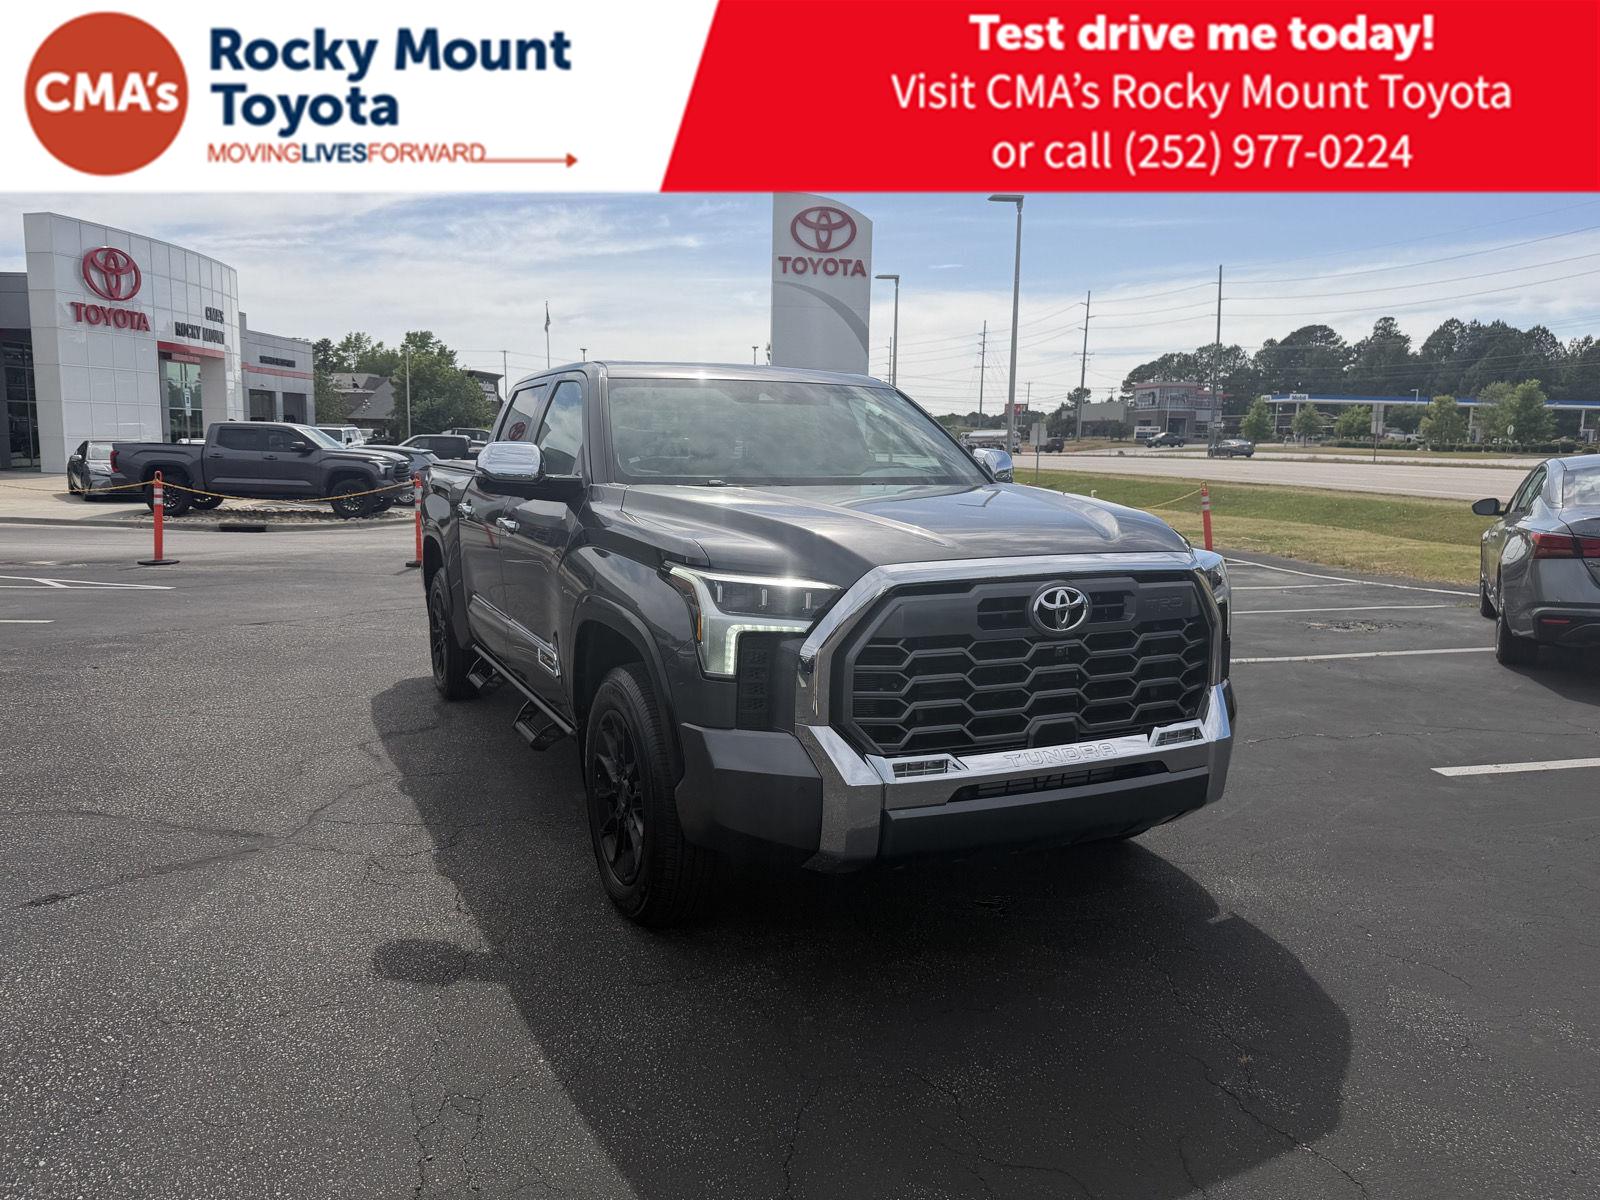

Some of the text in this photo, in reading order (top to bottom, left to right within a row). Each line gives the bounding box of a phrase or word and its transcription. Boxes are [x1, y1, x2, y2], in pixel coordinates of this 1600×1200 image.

[778, 256, 867, 277] TOYOTA
[71, 302, 150, 331] TOYOTA
[175, 321, 224, 344] ROCKY MOUNT
[1003, 743, 1118, 767] TUNDRA
